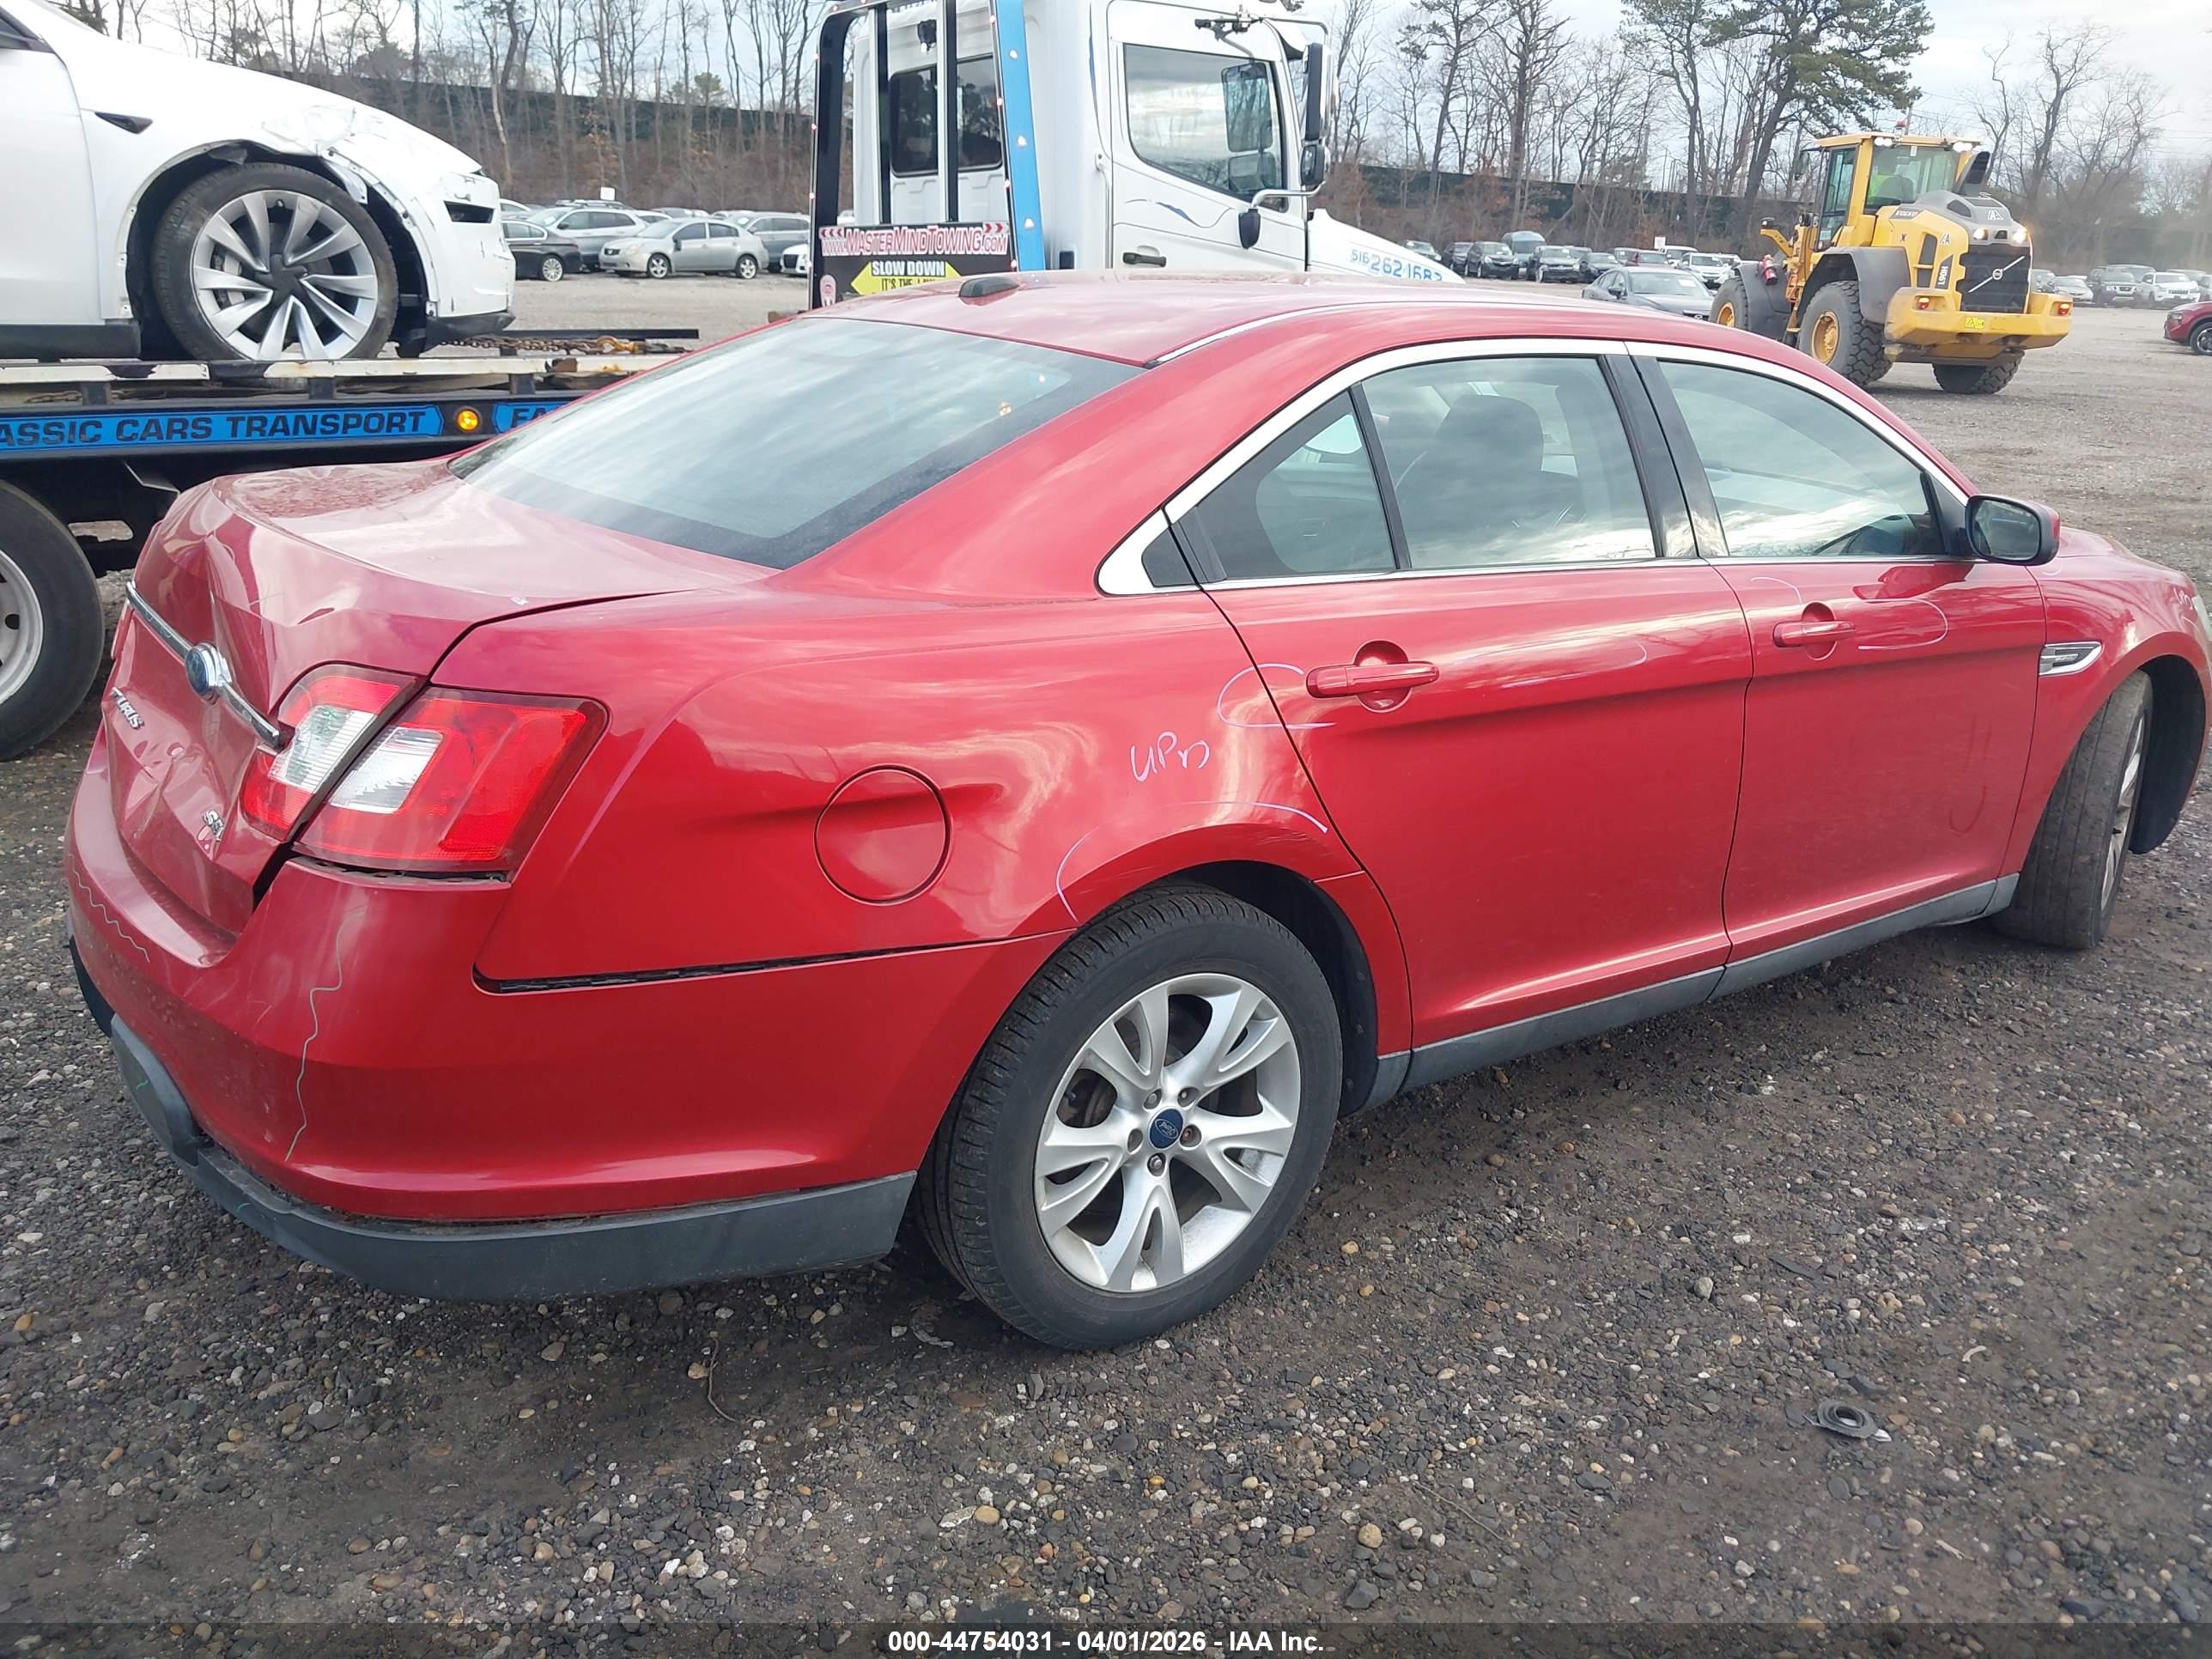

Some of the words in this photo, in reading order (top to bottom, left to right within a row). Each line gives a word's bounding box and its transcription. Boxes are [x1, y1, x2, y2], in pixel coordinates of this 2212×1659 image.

[1352, 250, 1370, 264] 516
[872, 261, 905, 276] SLOW
[907, 261, 945, 276] DOWN
[116, 417, 213, 441] CARS
[227, 411, 426, 439] TRANSPORT
